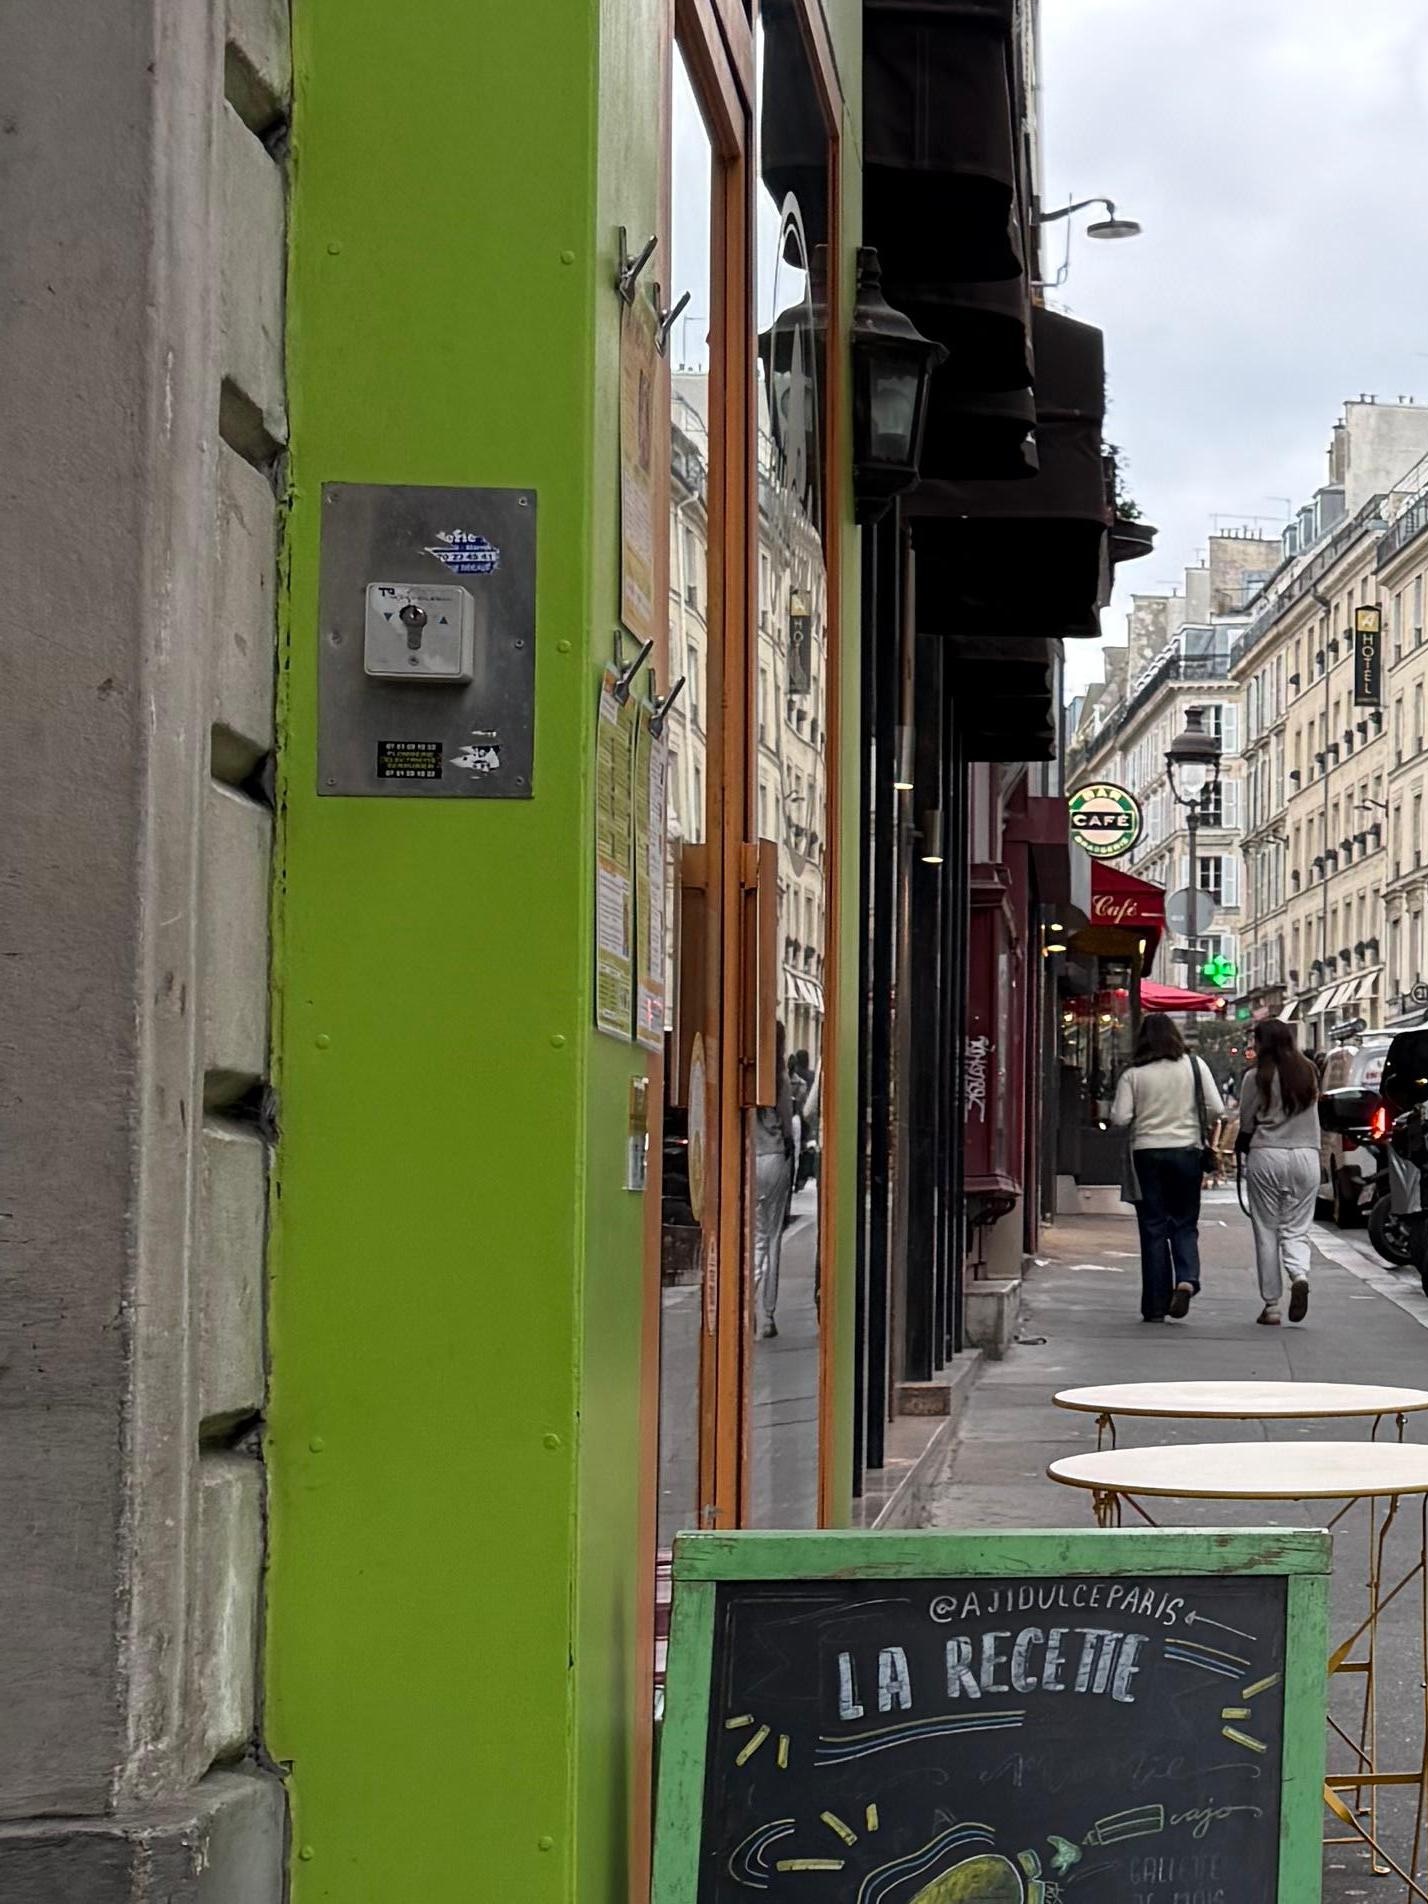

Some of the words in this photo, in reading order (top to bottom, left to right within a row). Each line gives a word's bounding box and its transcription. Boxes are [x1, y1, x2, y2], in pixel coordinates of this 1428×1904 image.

[1072, 813, 1130, 827] CAFÉ
[1092, 895, 1137, 924] Café
[929, 1584, 1184, 1625] @AJIDULCEPARIS
[838, 1646, 913, 1720] LA
[945, 1627, 1150, 1703] RECETTE
